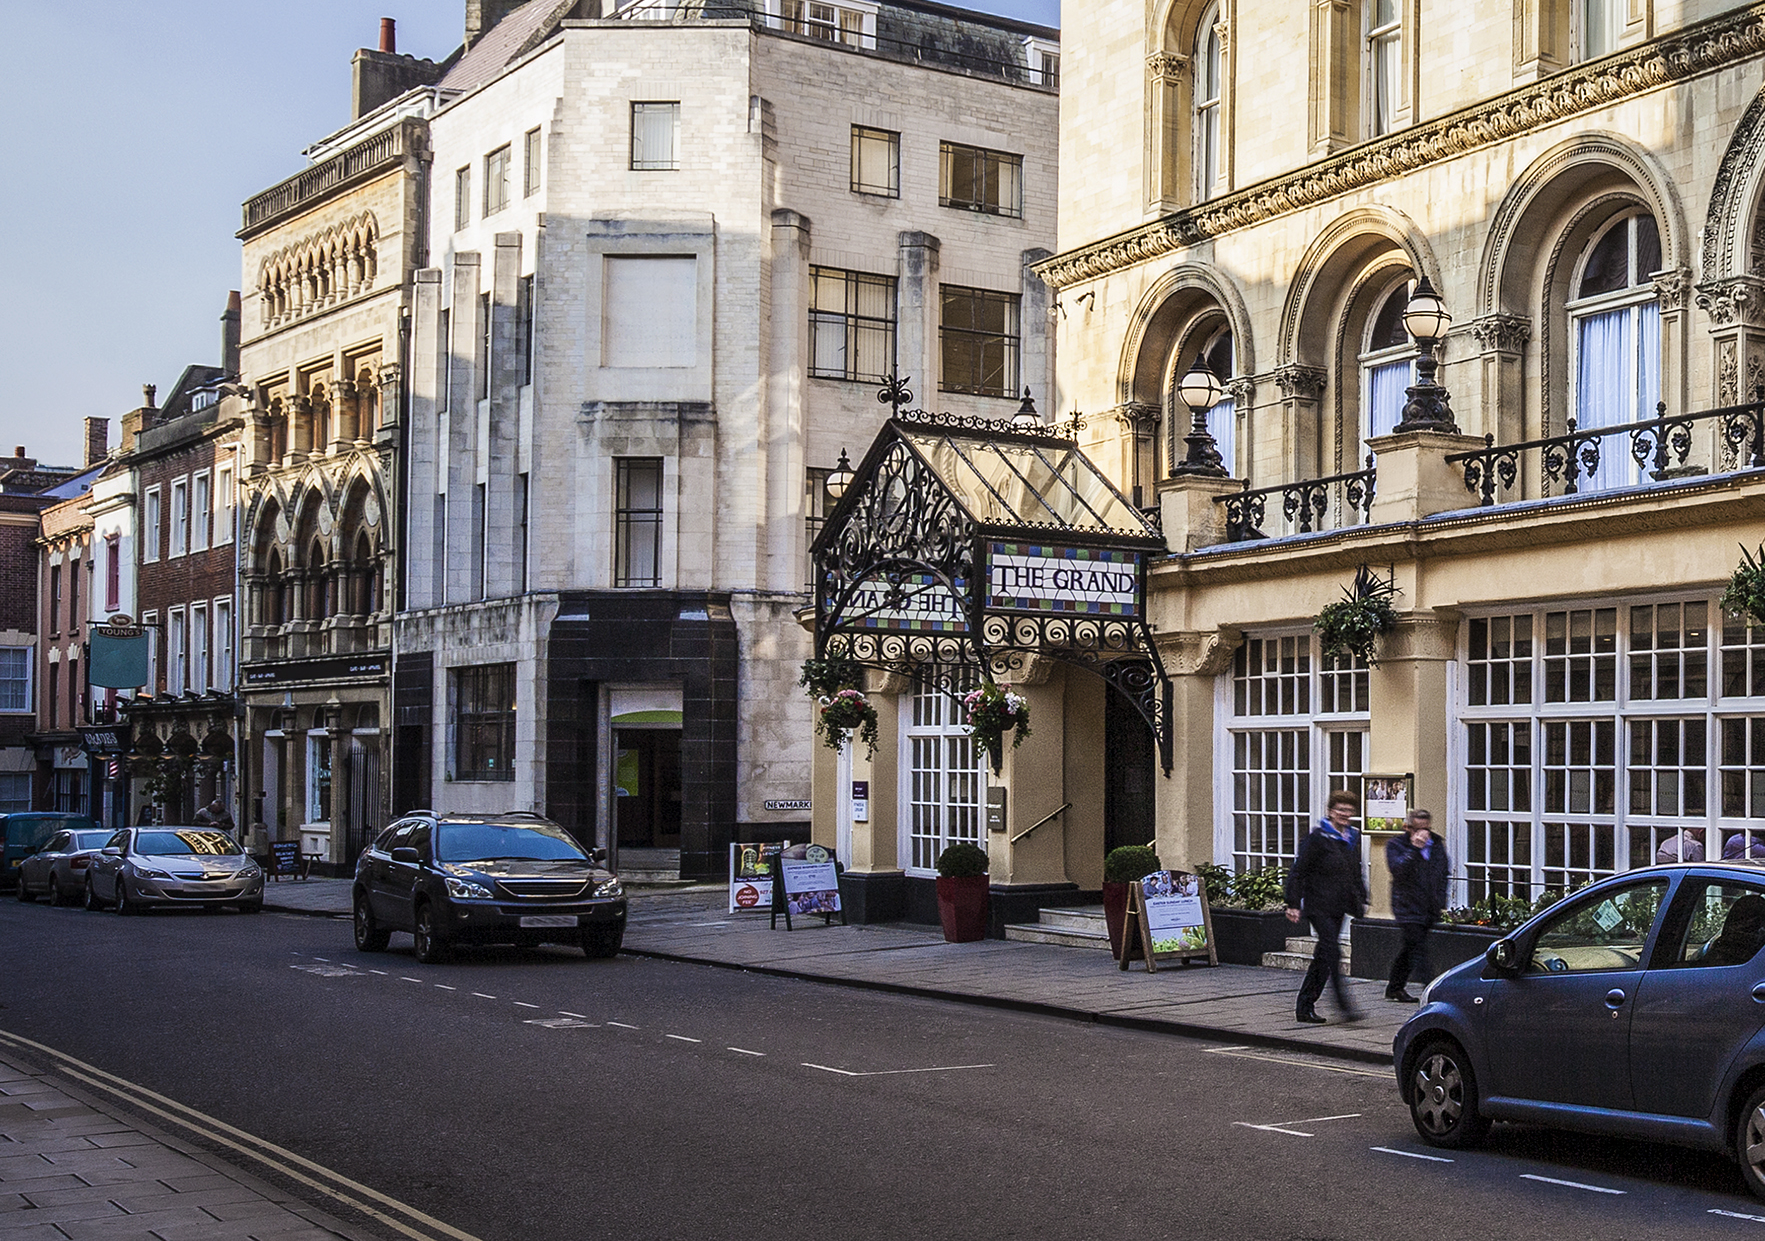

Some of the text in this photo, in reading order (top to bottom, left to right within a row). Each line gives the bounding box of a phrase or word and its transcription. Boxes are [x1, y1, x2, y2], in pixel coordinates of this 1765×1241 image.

[994, 565, 1135, 593] THE GRAND
[101, 628, 140, 636] YOUNG'S
